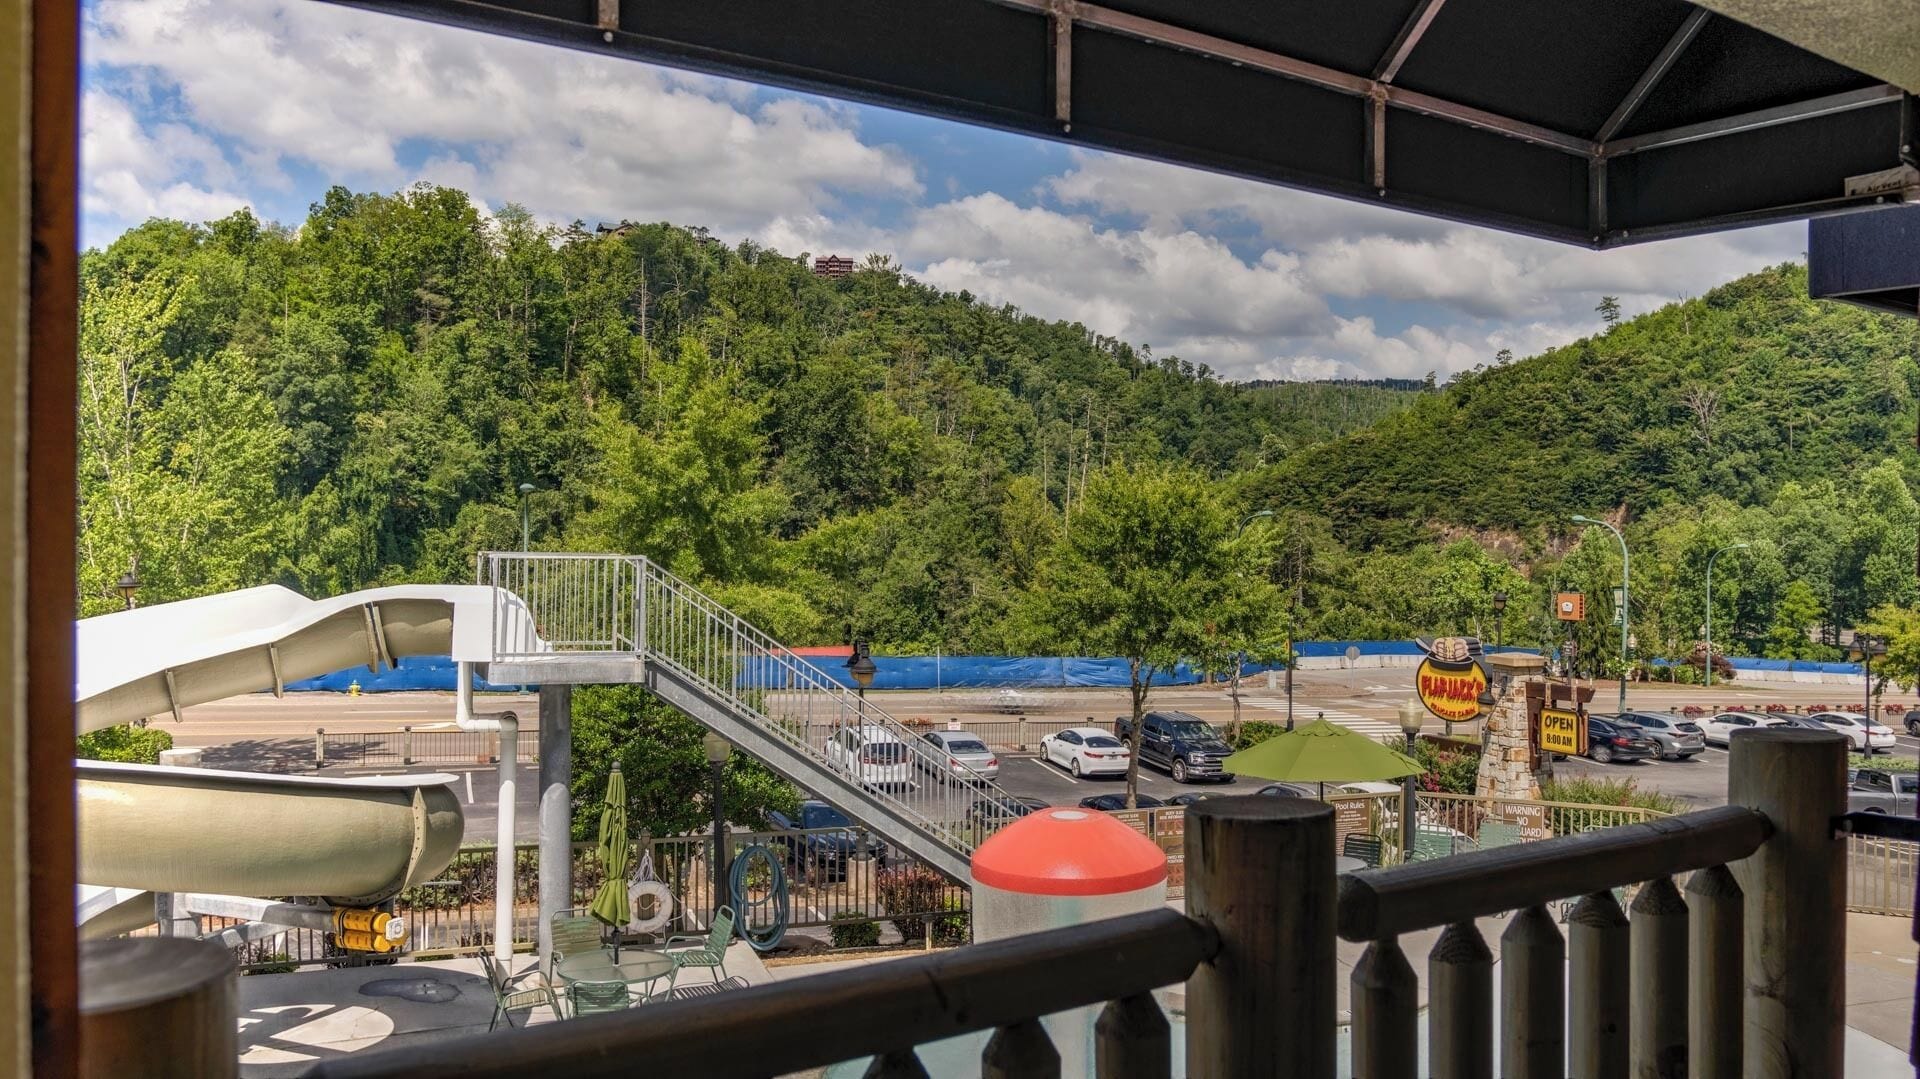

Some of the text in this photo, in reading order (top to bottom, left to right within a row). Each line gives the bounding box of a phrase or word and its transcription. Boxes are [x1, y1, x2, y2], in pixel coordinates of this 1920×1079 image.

[1545, 715, 1574, 732] OPEN
[1546, 733, 1572, 746] 8:00 AM
[1335, 802, 1349, 810] Pool
[1505, 805, 1541, 817] WARNING
[1516, 816, 1528, 826] NO
